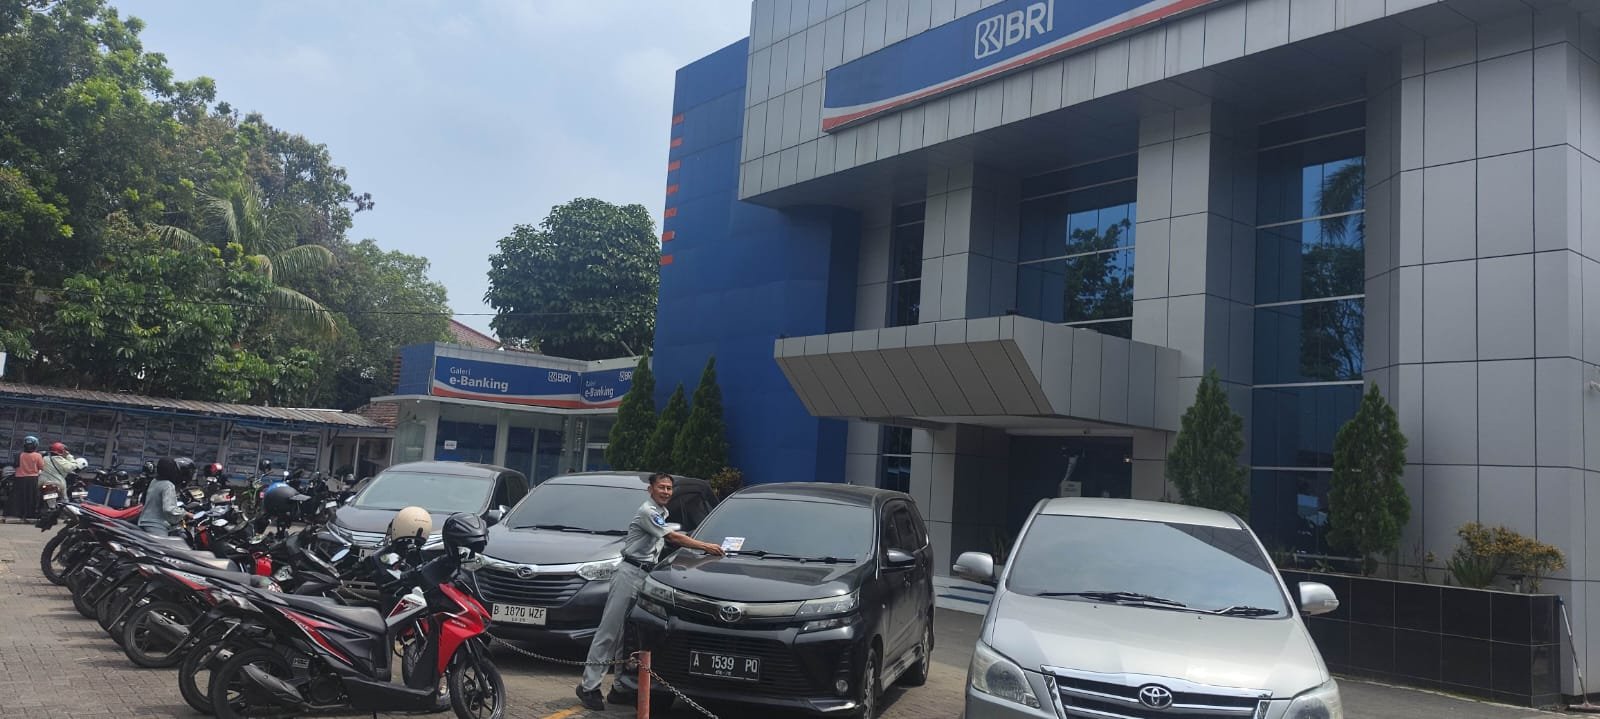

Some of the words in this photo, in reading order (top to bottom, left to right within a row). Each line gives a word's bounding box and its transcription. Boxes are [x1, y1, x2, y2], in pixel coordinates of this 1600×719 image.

[1005, 0, 1054, 47] BRI
[449, 366, 471, 375] Galeri
[449, 376, 509, 392] e-Banking
[557, 373, 571, 383] BRI
[584, 385, 614, 398] e-Banking
[493, 604, 500, 615] B
[504, 606, 526, 617] 1870
[693, 653, 700, 667] A
[711, 655, 735, 670] 1539
